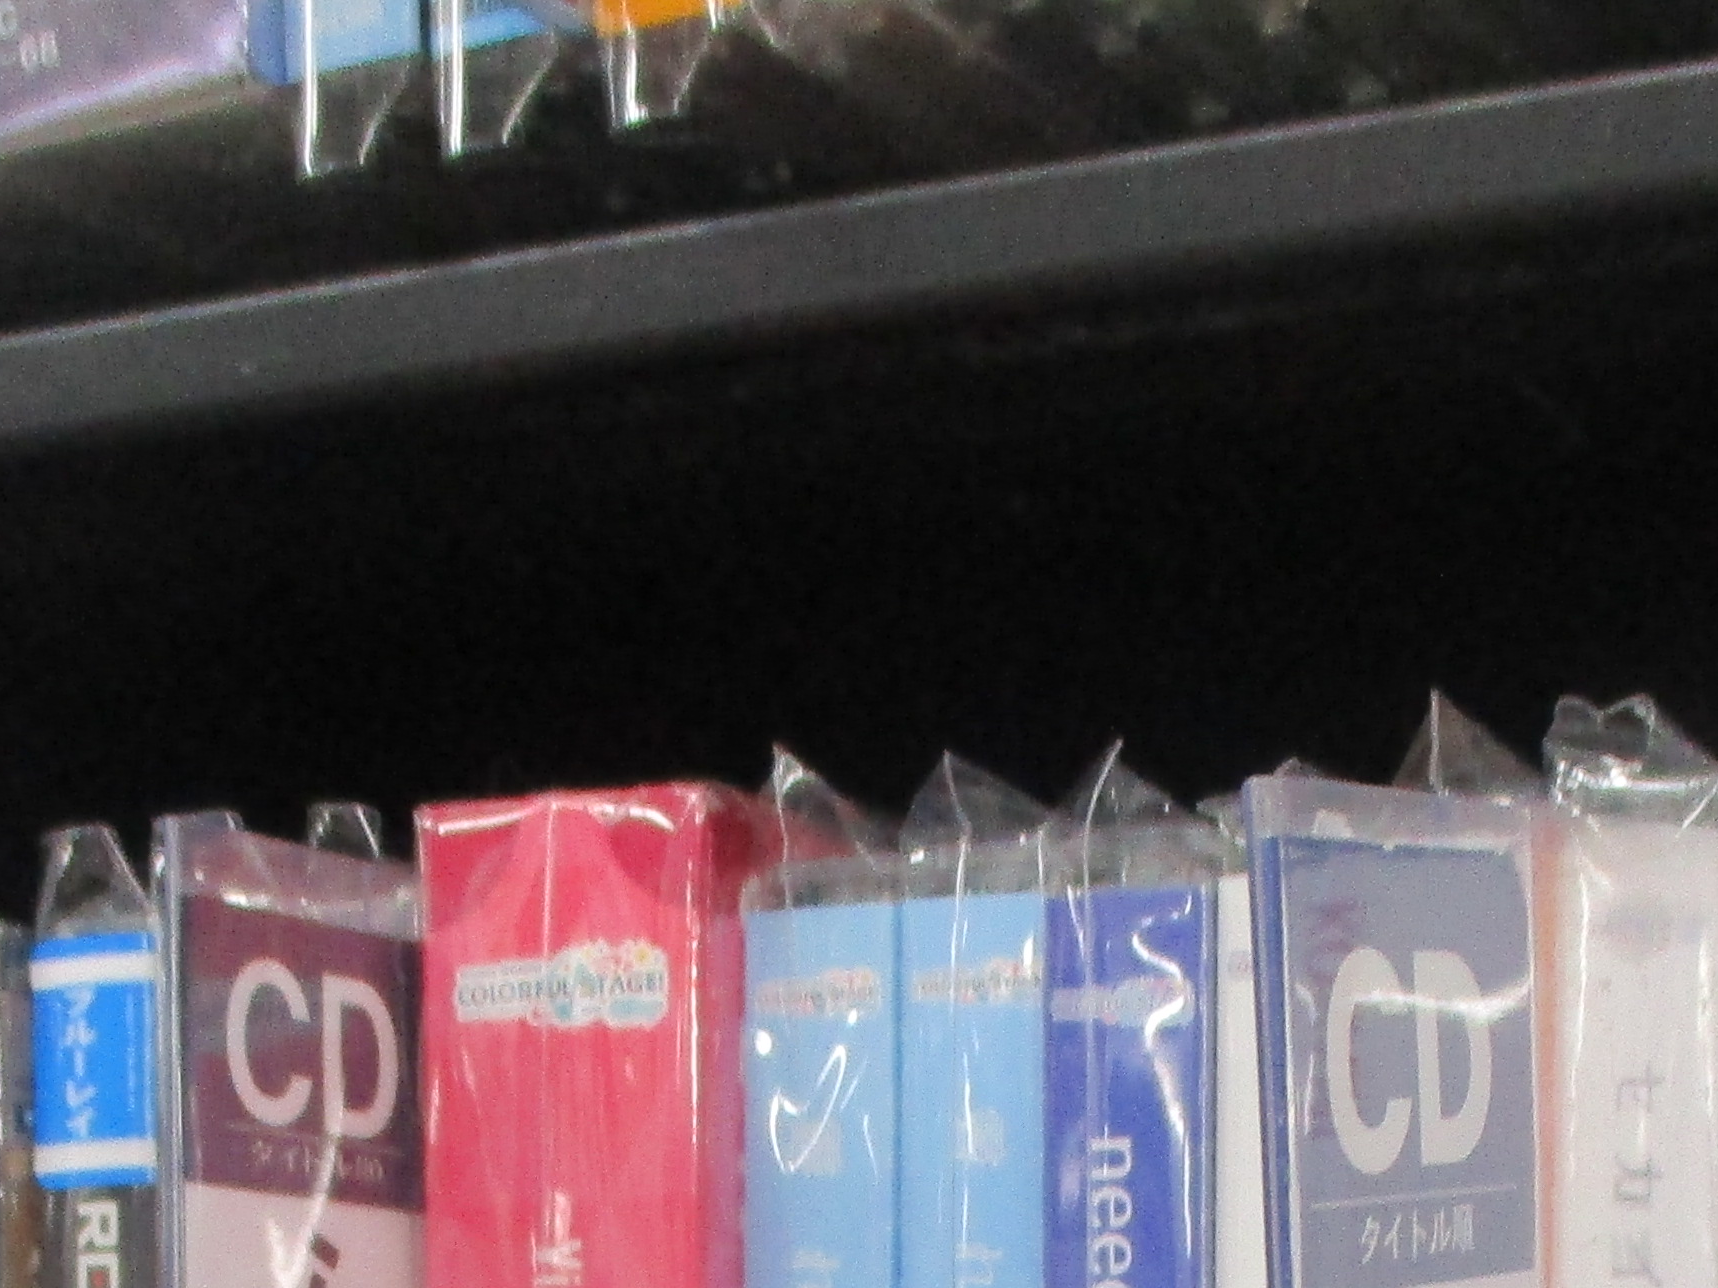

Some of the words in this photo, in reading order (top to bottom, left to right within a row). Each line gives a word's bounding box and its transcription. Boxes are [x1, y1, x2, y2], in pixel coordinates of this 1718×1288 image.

[226, 960, 400, 1137] CD
[1327, 946, 1493, 1176] CD
[1359, 1207, 1476, 1266] タイトル順
